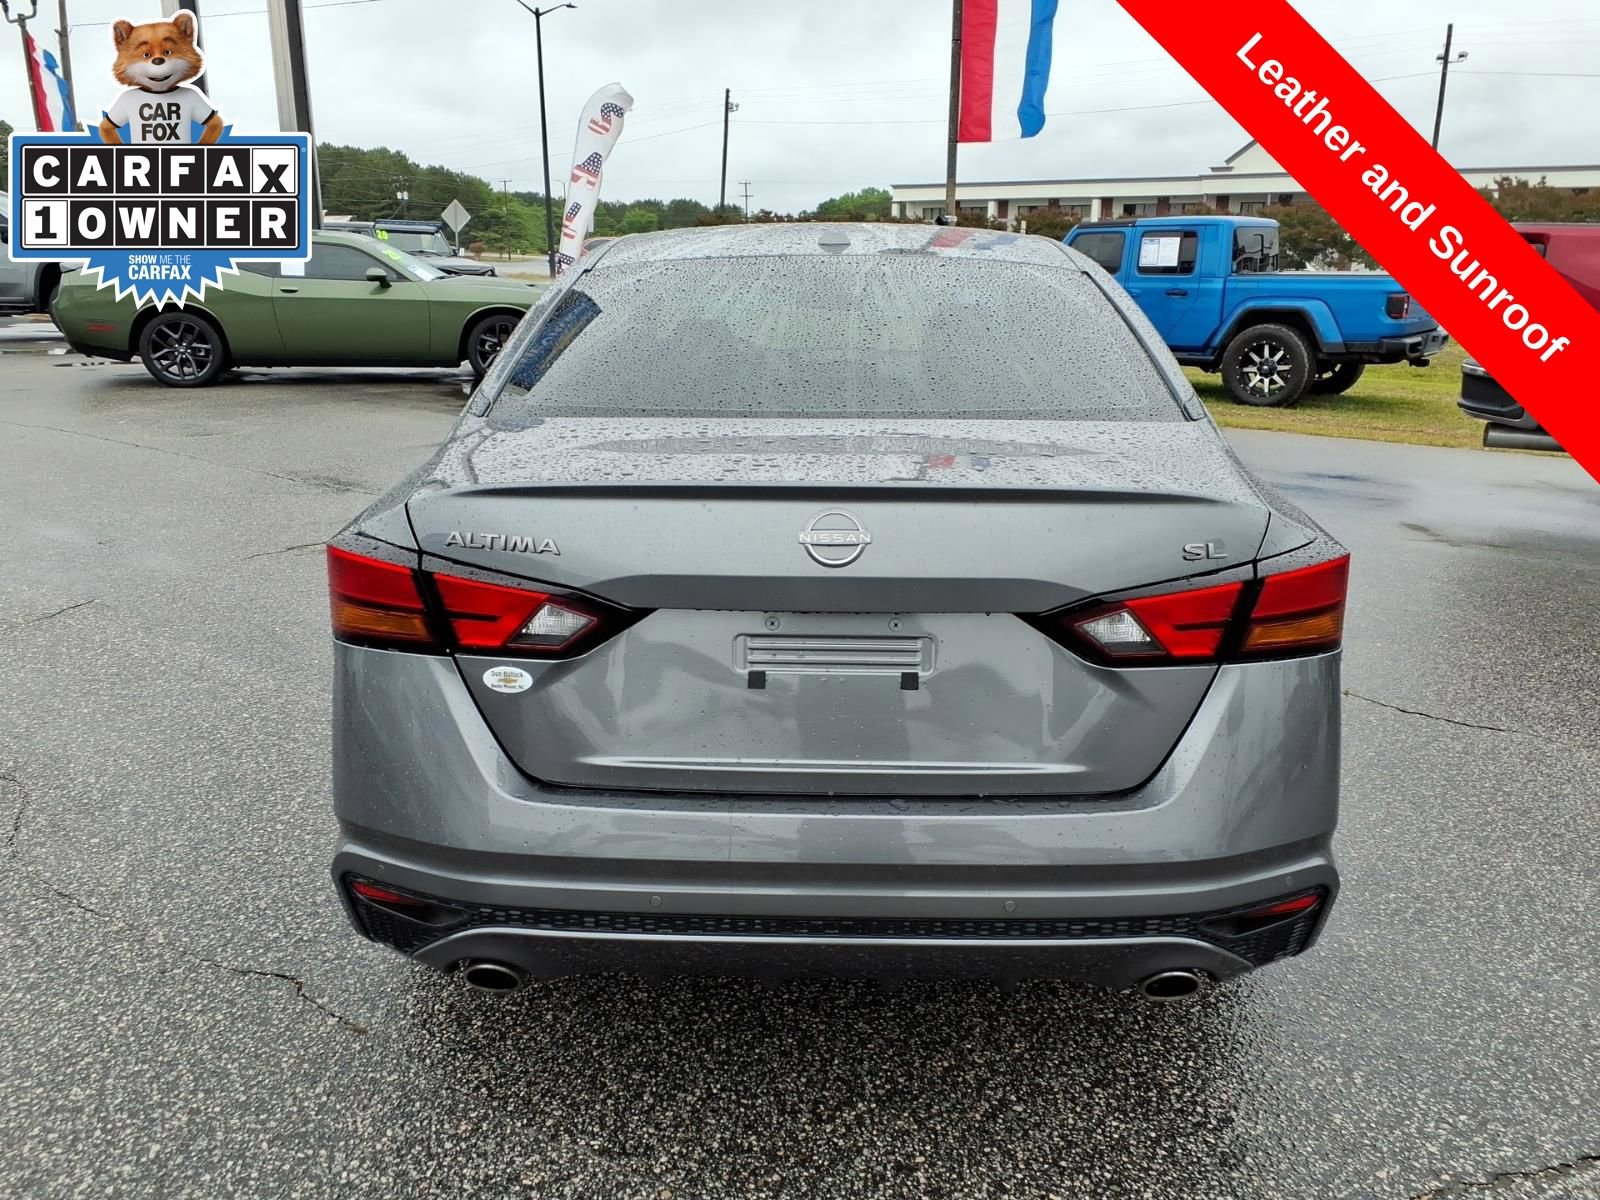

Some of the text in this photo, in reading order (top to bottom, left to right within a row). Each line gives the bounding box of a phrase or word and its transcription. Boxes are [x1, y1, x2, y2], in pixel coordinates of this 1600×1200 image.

[443, 530, 561, 556] ALTIMA
[798, 532, 871, 543] NISSAN
[1182, 542, 1228, 561] SL
